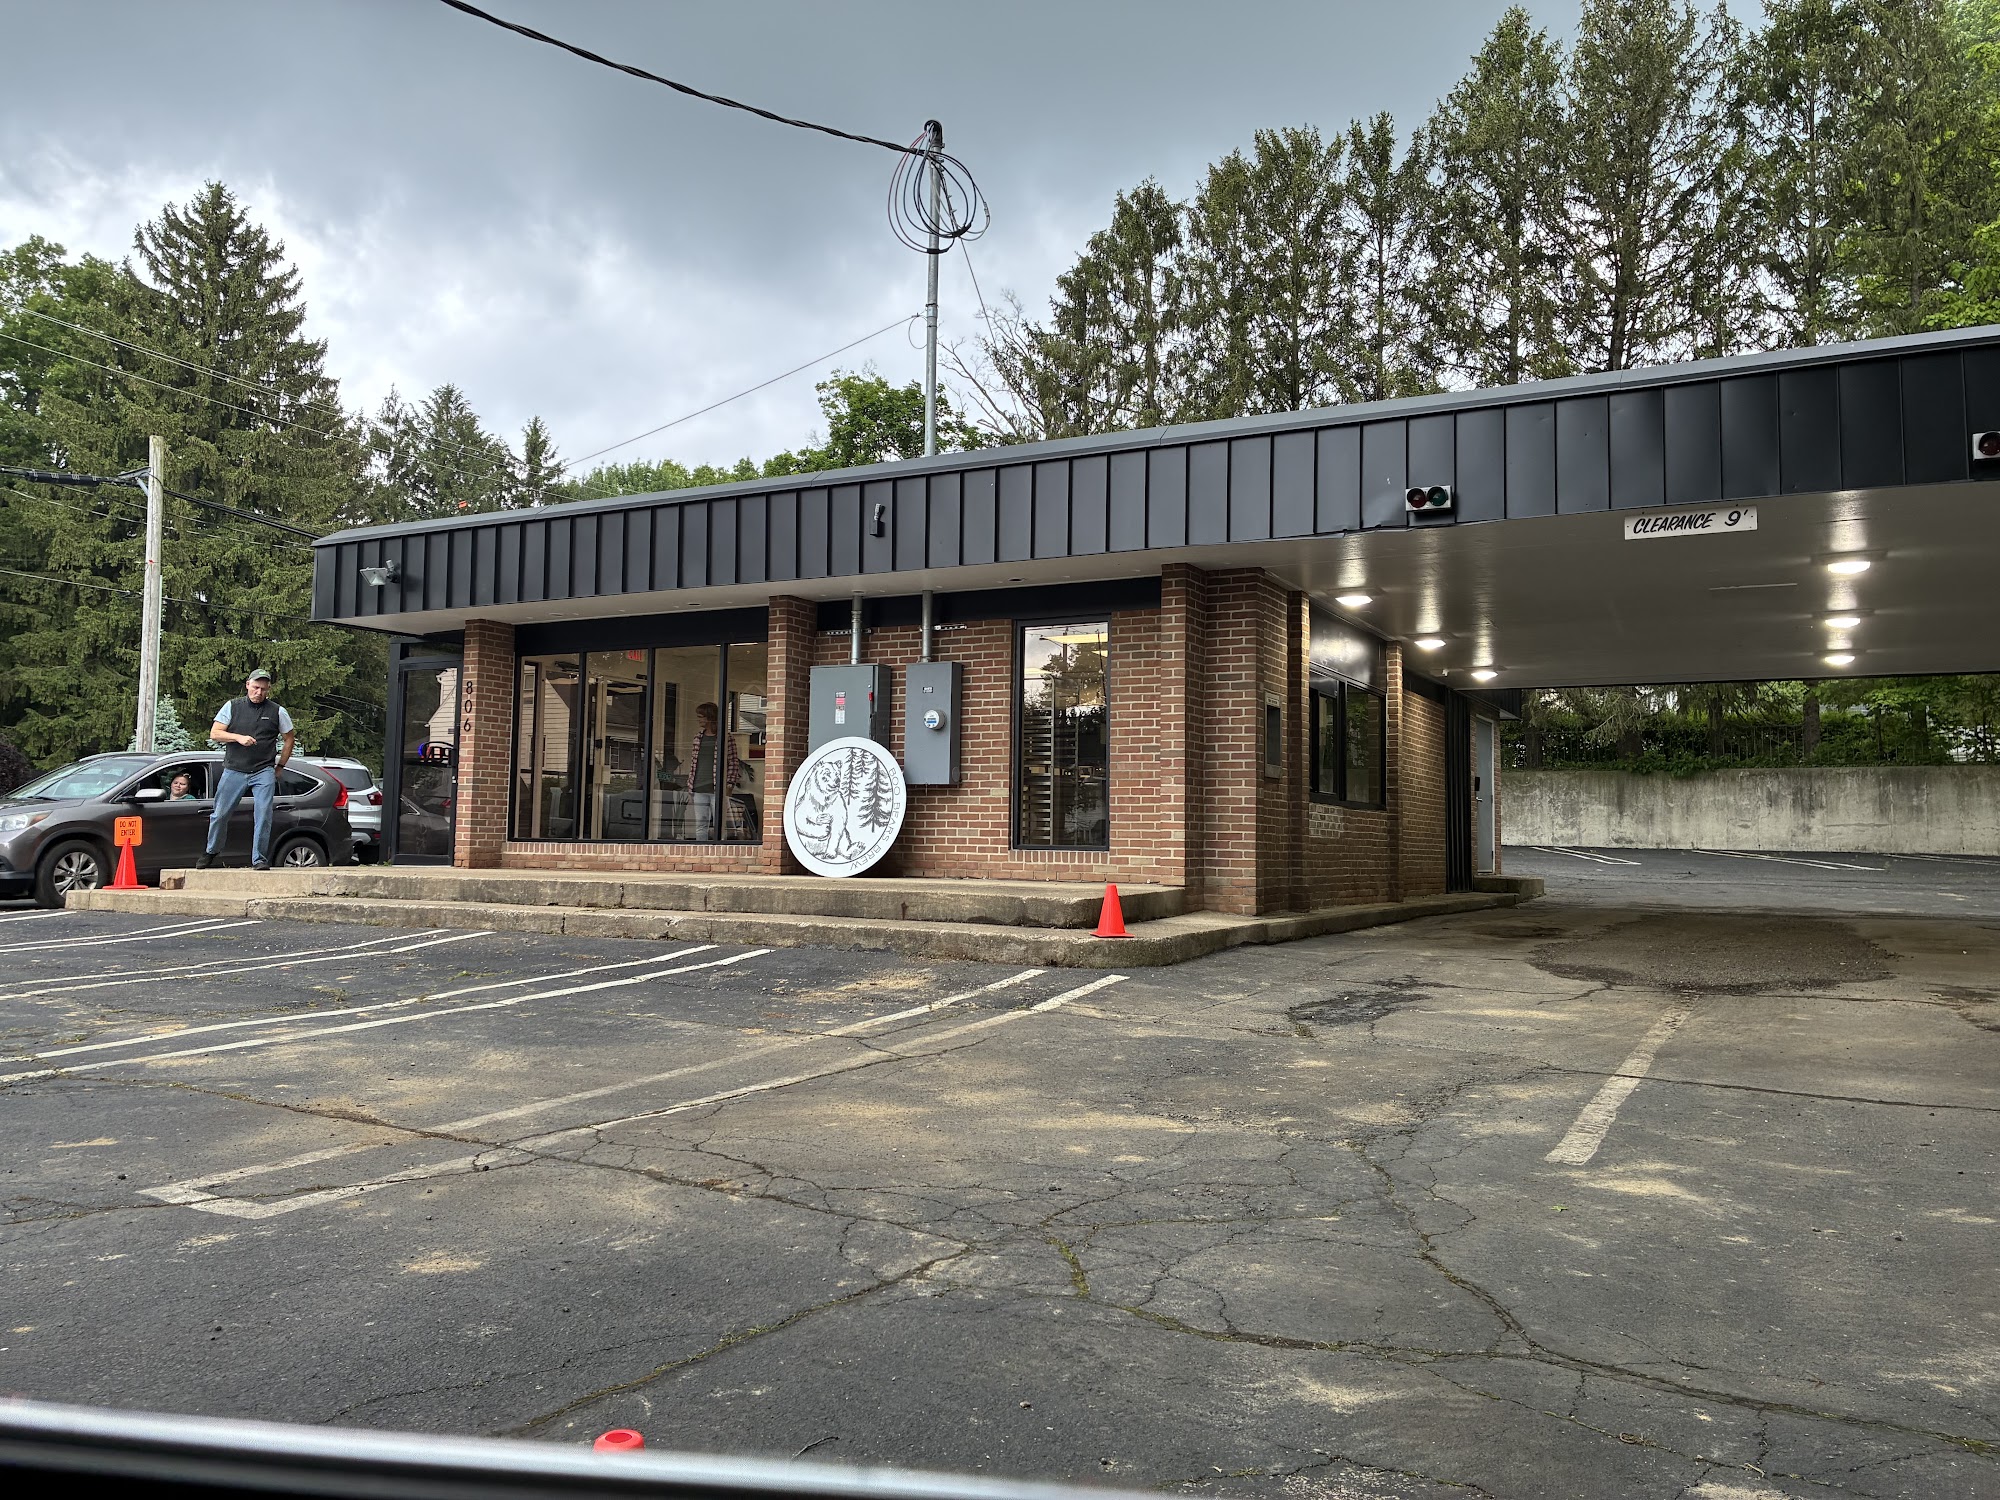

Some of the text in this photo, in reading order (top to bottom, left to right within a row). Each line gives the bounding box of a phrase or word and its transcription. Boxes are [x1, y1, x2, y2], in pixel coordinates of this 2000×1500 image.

[1633, 508, 1749, 534] CLEARANCE 9'
[463, 680, 473, 732] 806
[119, 820, 137, 828] DO NOT
[849, 767, 901, 871] BOO BEARS BREW
[120, 829, 136, 837] ENTER
